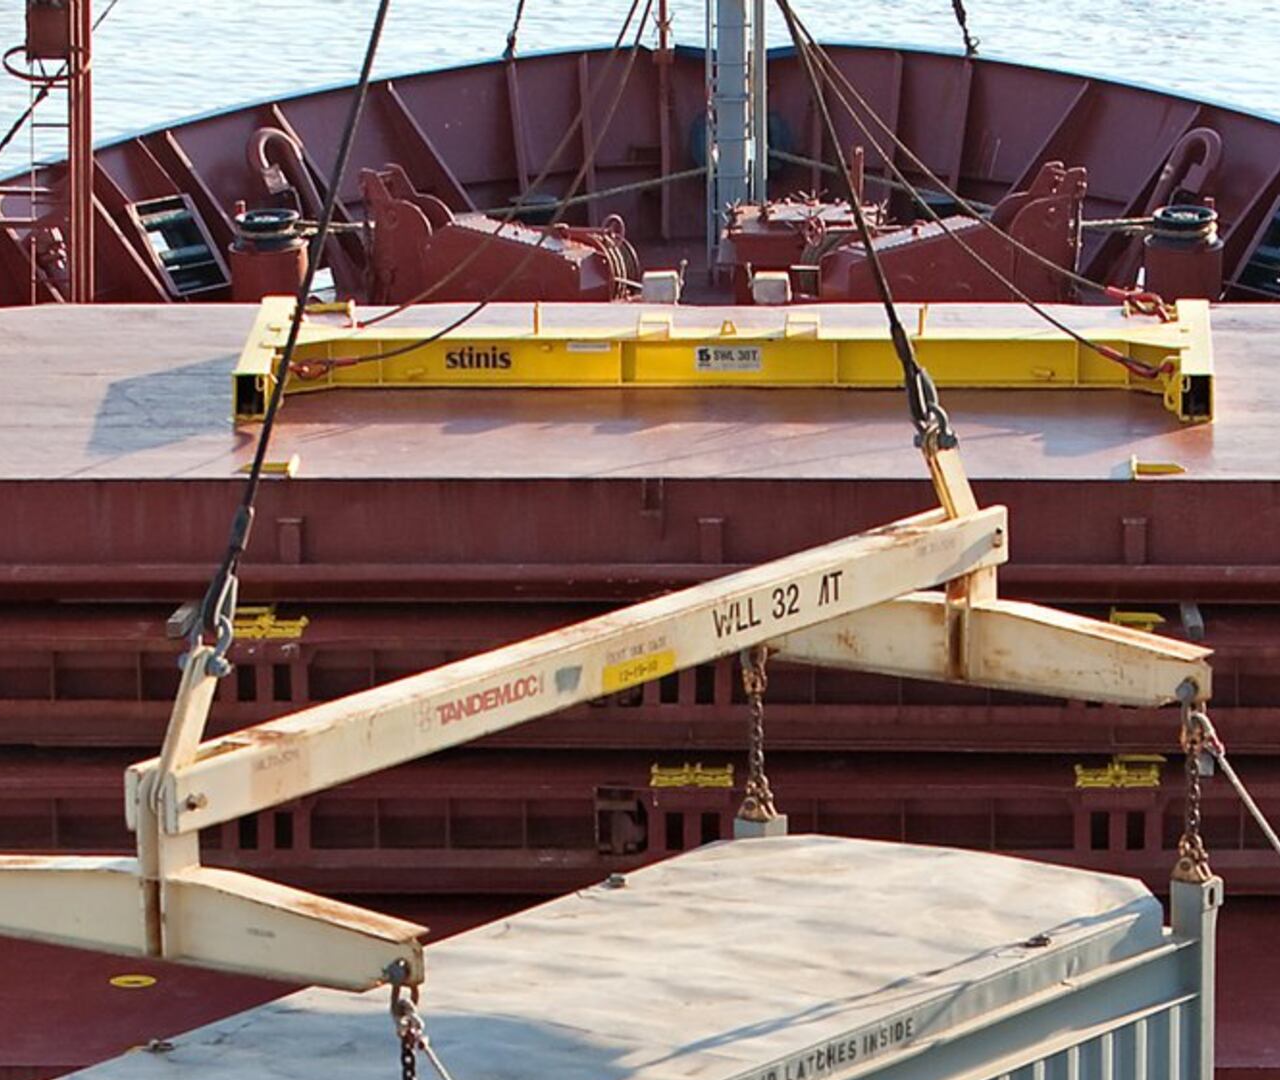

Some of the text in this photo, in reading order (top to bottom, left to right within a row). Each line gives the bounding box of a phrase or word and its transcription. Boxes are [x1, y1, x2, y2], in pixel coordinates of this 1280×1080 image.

[446, 346, 511, 369] stinis
[713, 597, 761, 638] WLL
[772, 584, 800, 619] 32
[864, 1017, 913, 1054] INSIDE
